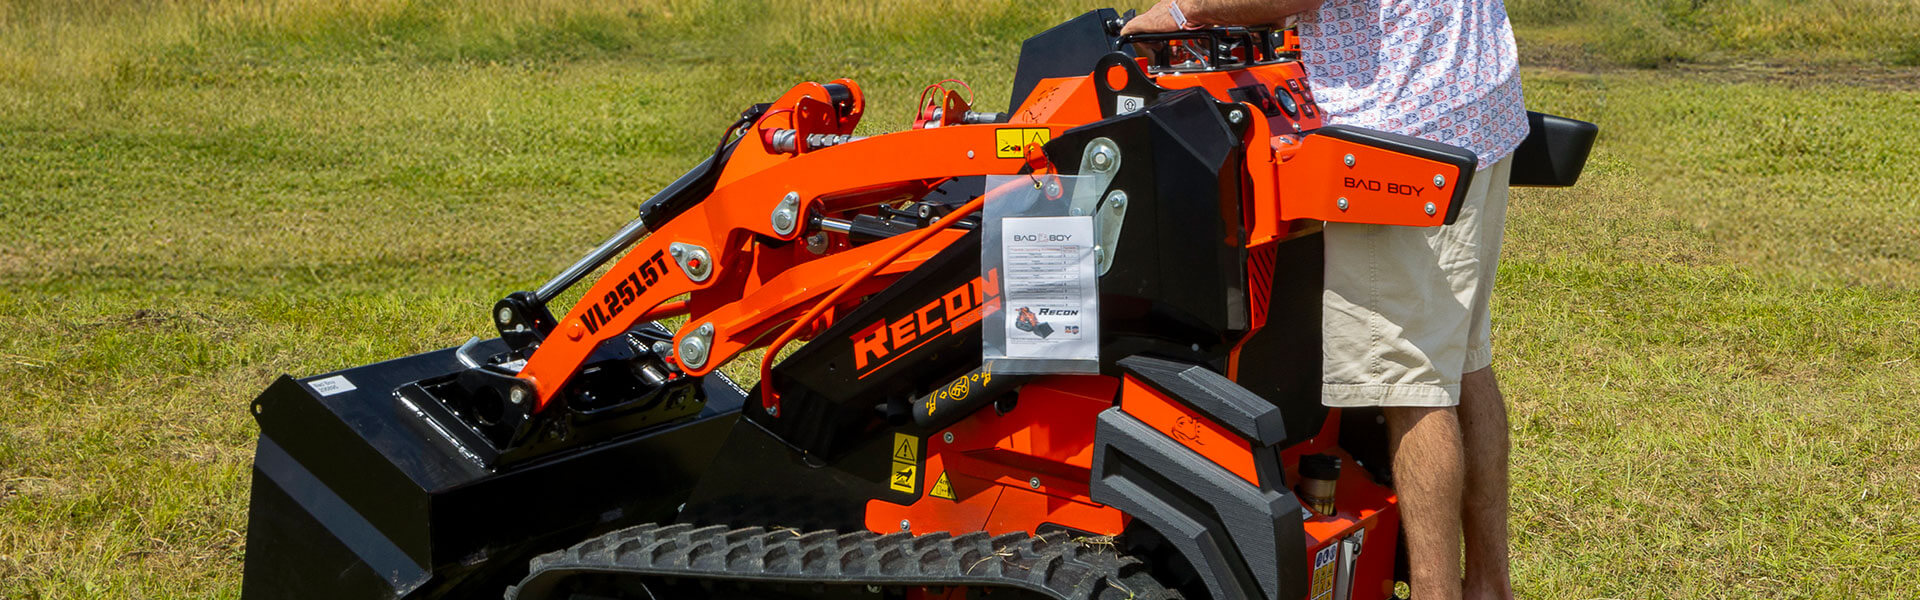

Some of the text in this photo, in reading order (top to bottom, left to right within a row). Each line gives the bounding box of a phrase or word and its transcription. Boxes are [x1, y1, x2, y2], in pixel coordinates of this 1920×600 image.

[1344, 177, 1424, 197] BAD BOY
[1014, 234, 1072, 242] BAD BOY
[579, 248, 669, 336] VL2515T
[849, 267, 1000, 370] RECON
[1039, 307, 1079, 316] RECON
